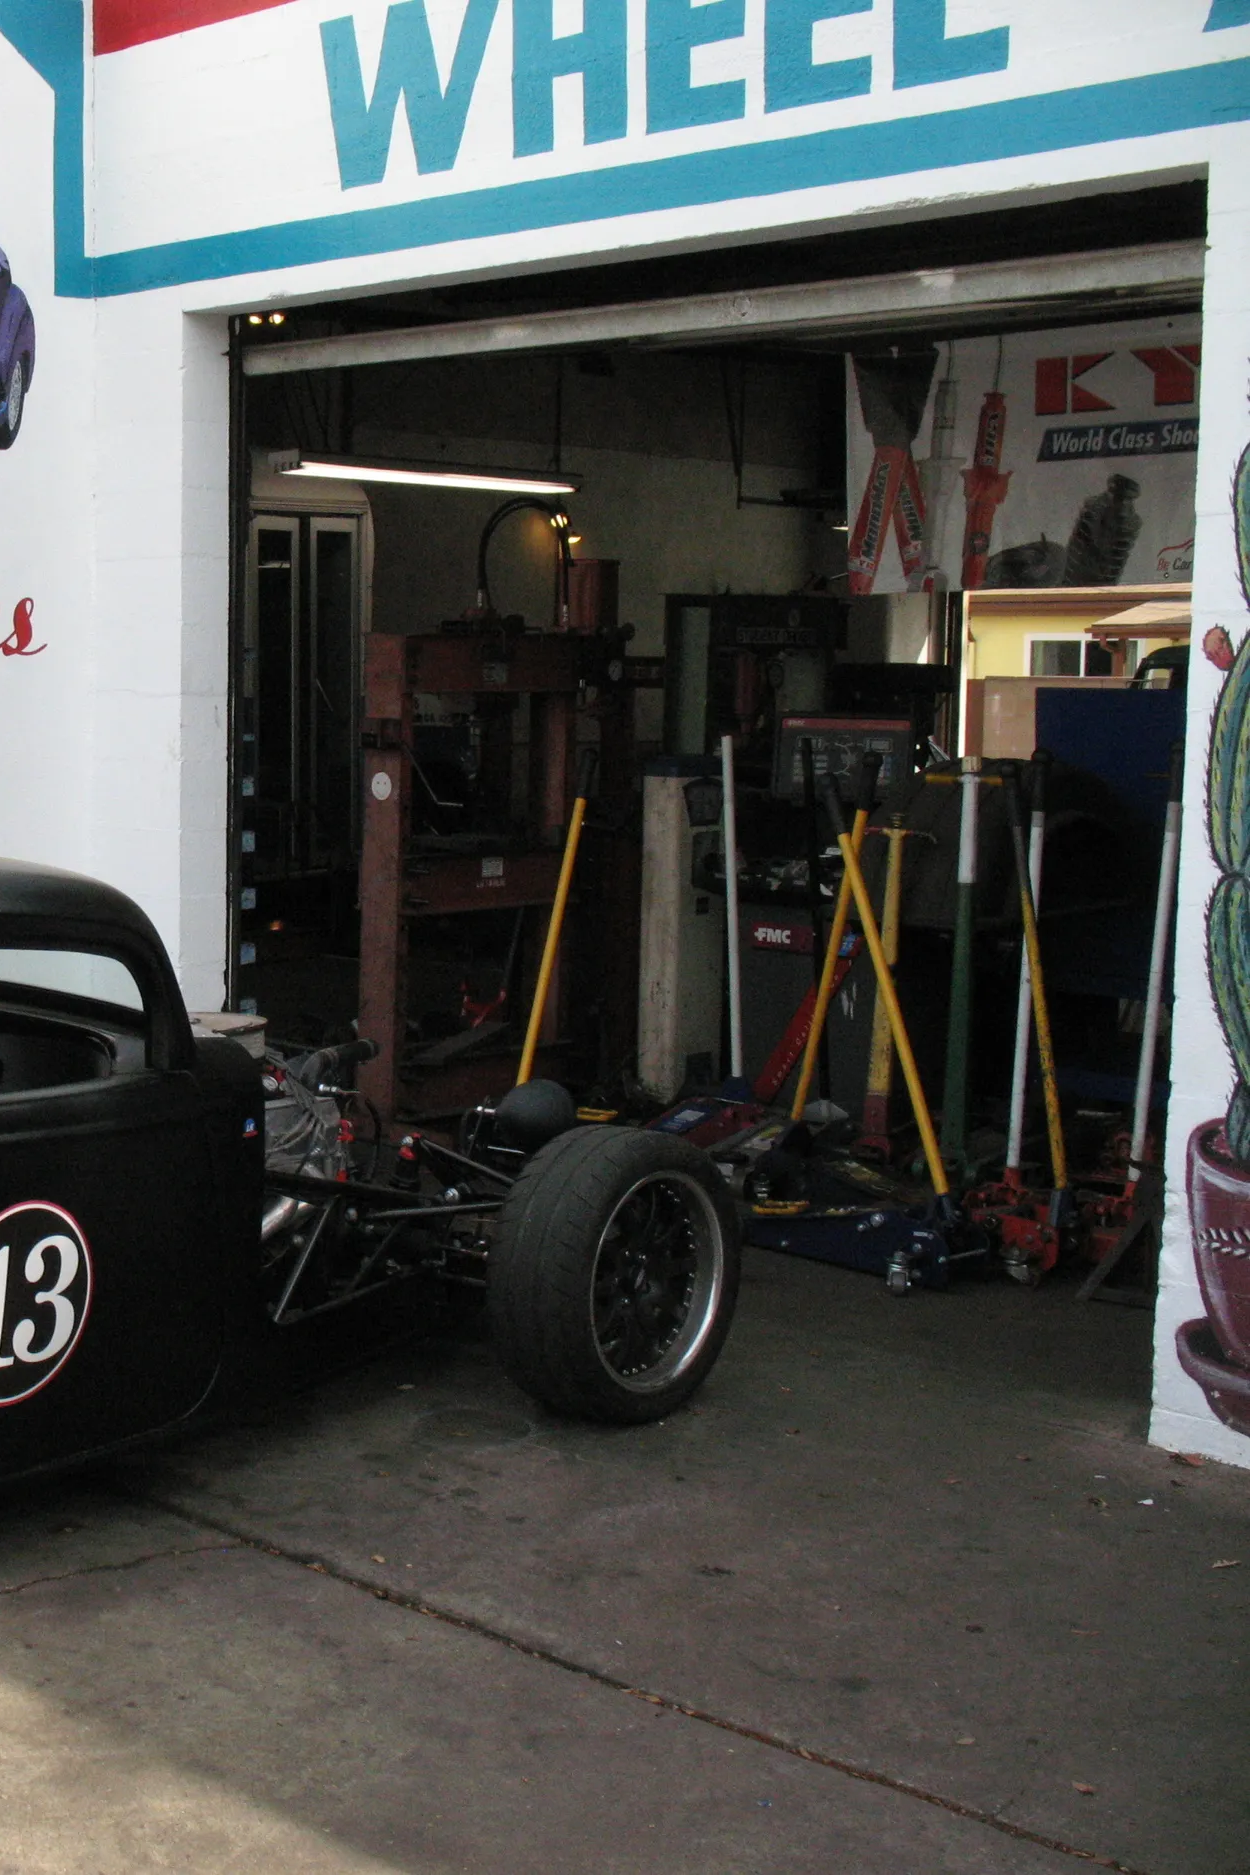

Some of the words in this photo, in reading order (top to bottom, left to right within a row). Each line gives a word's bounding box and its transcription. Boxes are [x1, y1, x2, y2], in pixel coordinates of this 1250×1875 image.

[1052, 429, 1103, 454] World
[1108, 427, 1154, 450] Class
[755, 927, 792, 945] FMC
